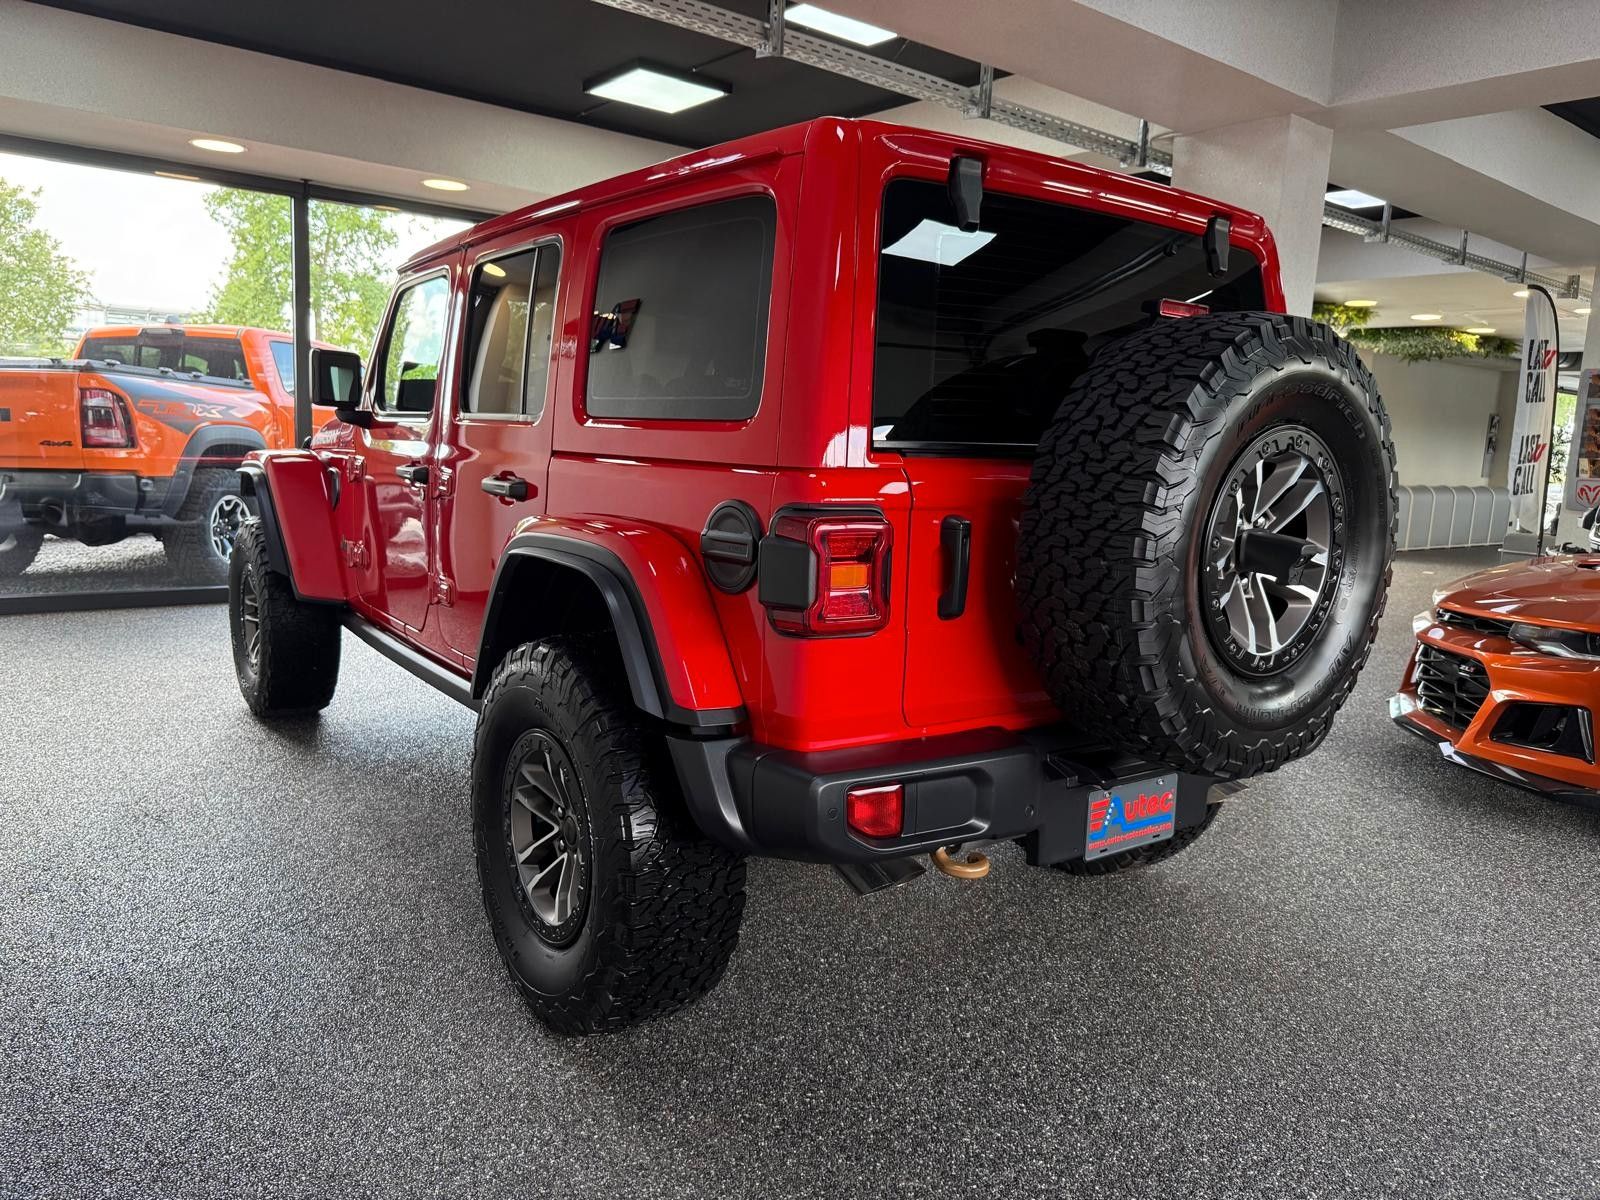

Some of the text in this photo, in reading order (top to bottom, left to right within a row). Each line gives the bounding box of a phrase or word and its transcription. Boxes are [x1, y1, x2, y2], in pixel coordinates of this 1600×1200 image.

[1527, 339, 1549, 370] LAST
[1526, 371, 1545, 403] CALL
[1518, 434, 1541, 464] LAST
[1513, 464, 1535, 495] CALL
[1088, 791, 1173, 841] Autec
